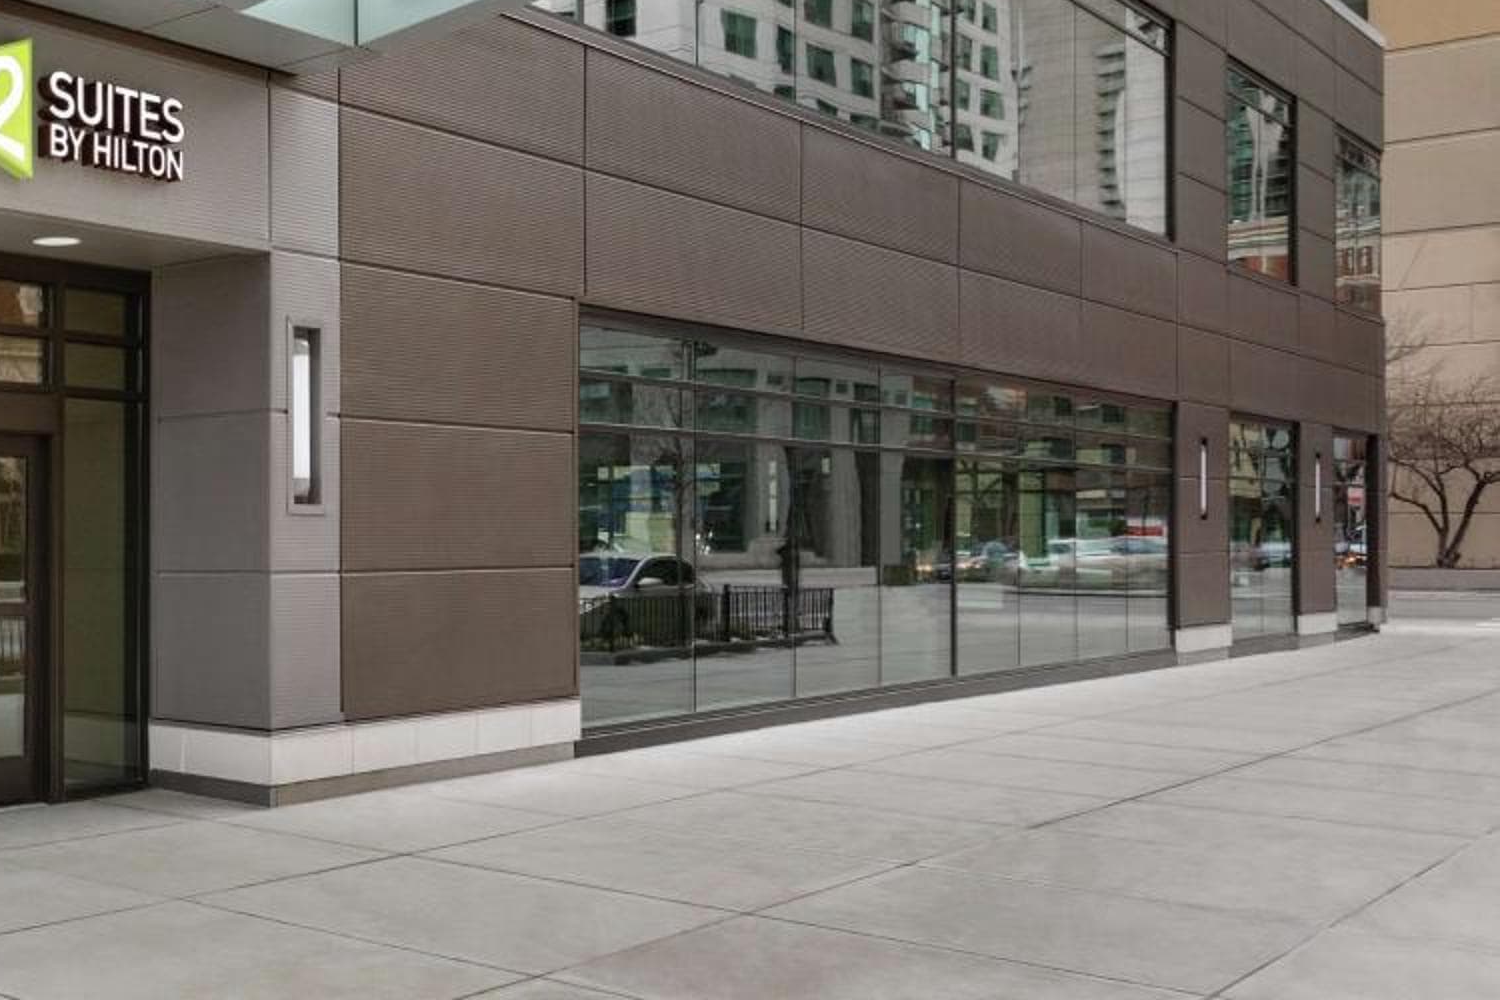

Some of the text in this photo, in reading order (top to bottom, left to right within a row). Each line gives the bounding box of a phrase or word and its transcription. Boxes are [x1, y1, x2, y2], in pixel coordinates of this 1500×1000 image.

[49, 70, 185, 144] SUITES
[50, 122, 184, 181] BY HILTON
